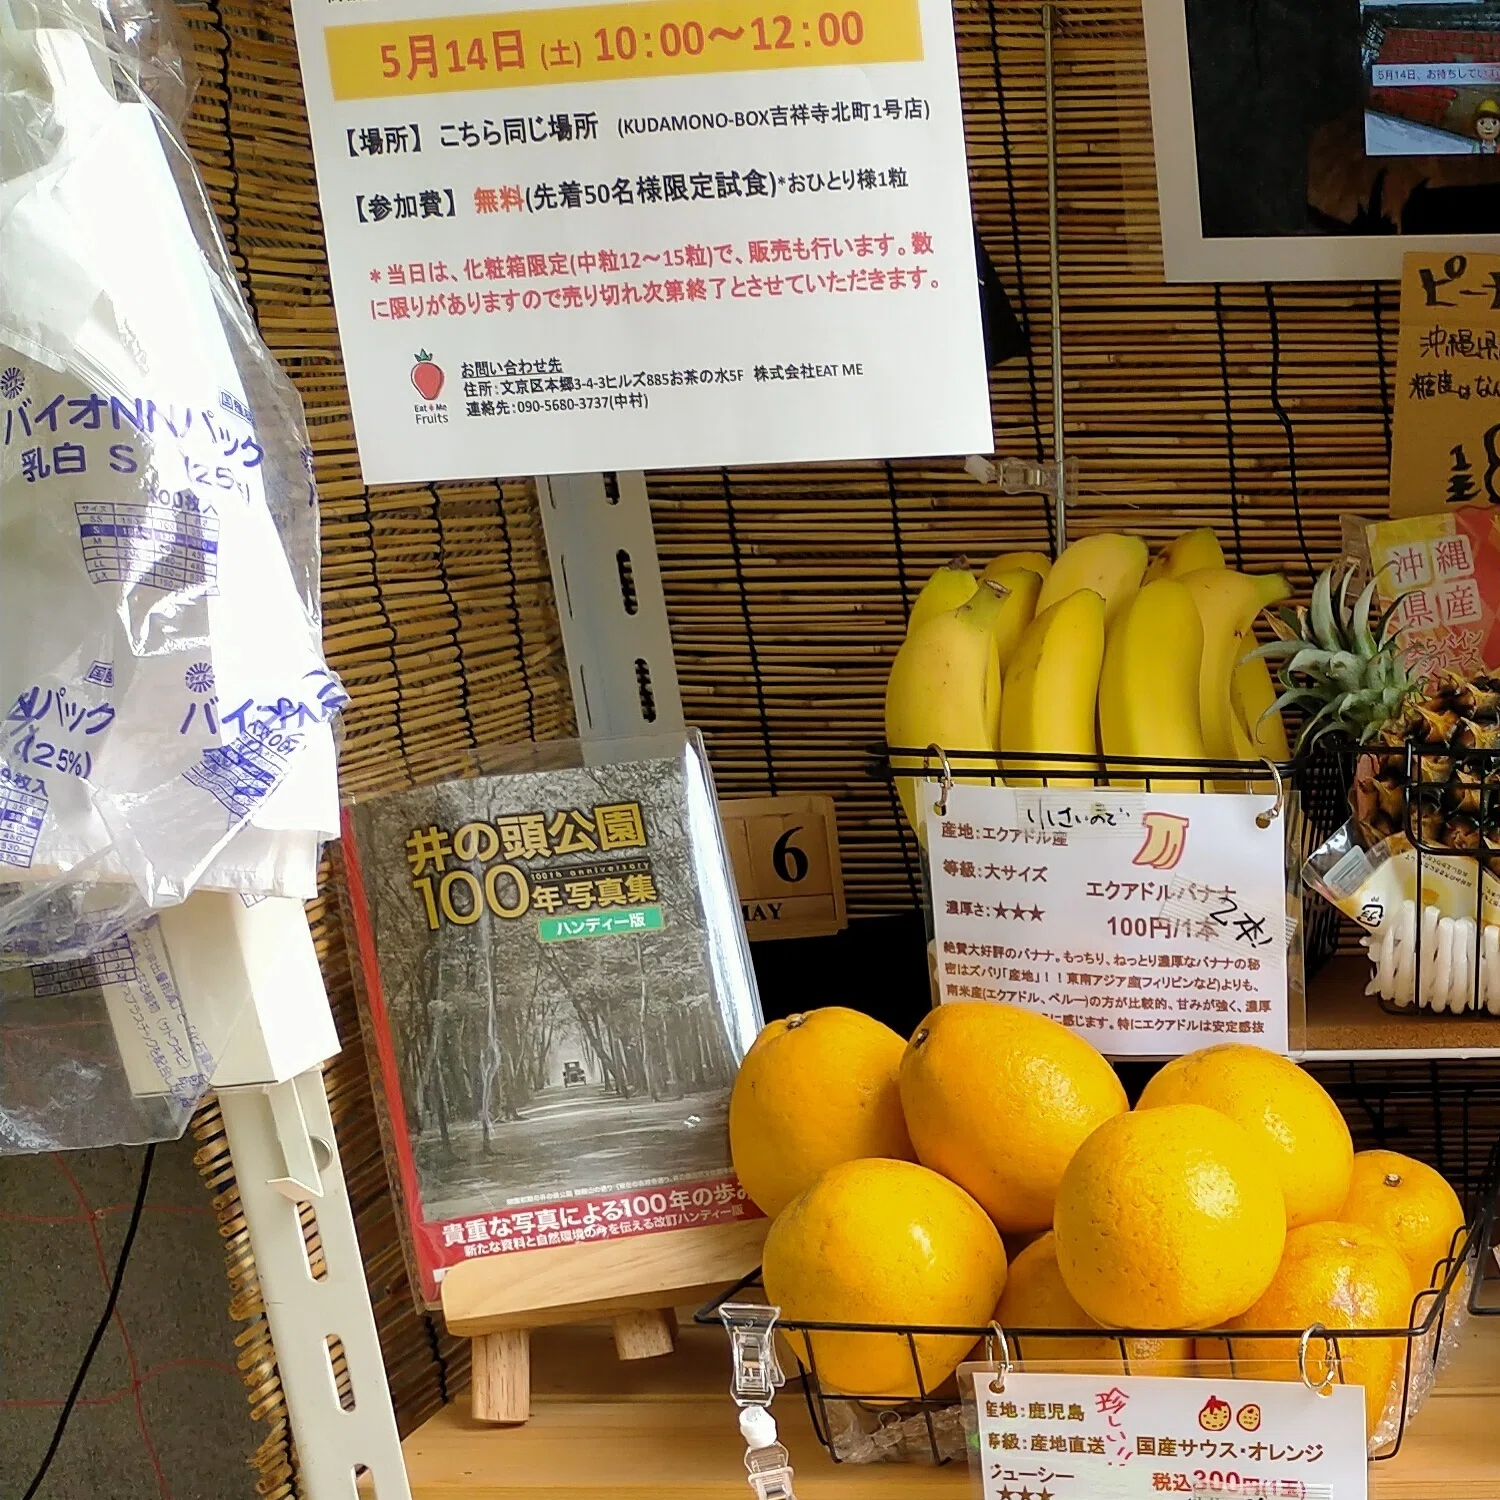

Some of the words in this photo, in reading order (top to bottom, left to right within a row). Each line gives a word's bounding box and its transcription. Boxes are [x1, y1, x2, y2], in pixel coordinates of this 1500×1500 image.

[380, 28, 526, 80] 5月14日
[540, 39, 583, 70] (土)
[345, 122, 422, 157] 【場所】
[440, 112, 599, 148] こちら同じ場所
[617, 99, 931, 138] (KUDAMONO-BOX吉祥寺北町1号店)
[355, 189, 457, 223] 【参加費】
[461, 358, 562, 376] お問い合わせ先
[842, 362, 863, 378] ME
[414, 404, 427, 412] Eat
[415, 413, 448, 424] Fruits
[23, 443, 86, 482] 乳白
[109, 445, 137, 473] S
[407, 802, 647, 876] 井の頭公園
[941, 821, 1068, 846] 産地:エクアドル産
[773, 826, 808, 882] 6
[943, 858, 1048, 882] 等級:大サイズ
[1086, 881, 1237, 902] エクアドルバナナ
[557, 912, 646, 935] ハンディー版
[1107, 917, 1220, 941] 100円/1本
[1136, 1436, 1324, 1463] 国産サウス・オレンジ
